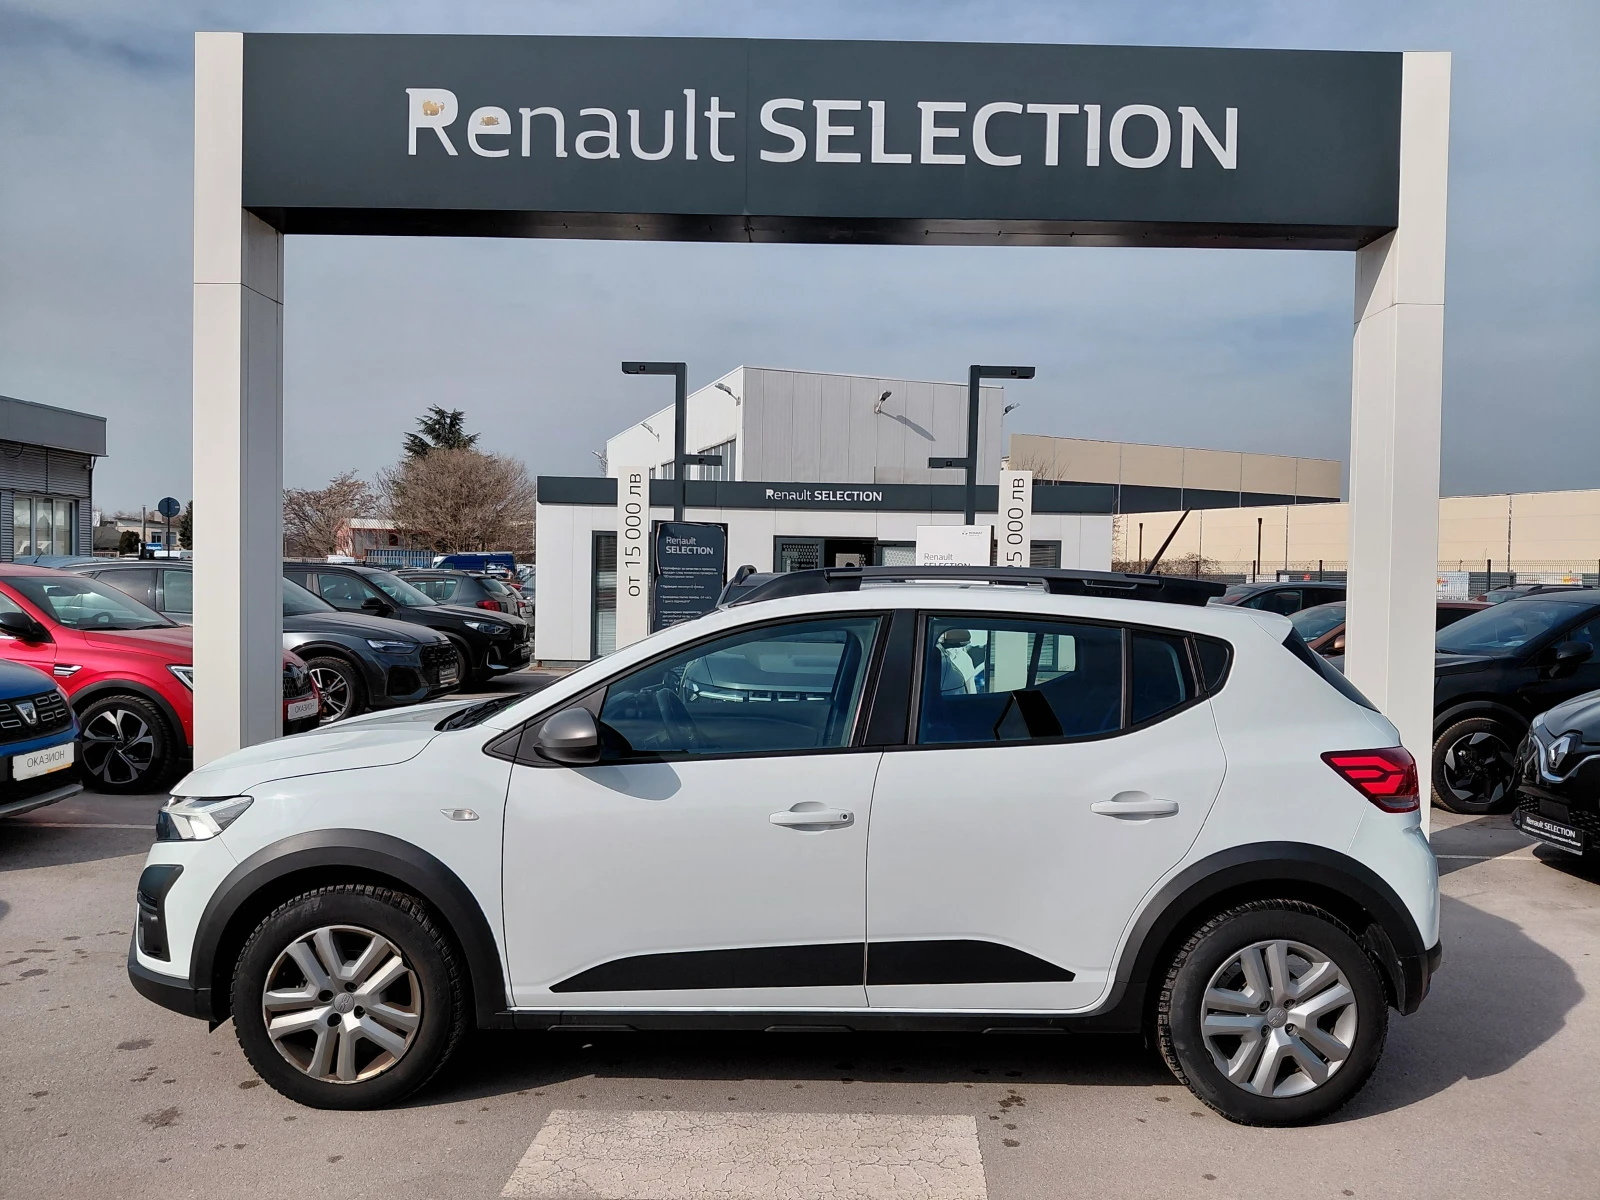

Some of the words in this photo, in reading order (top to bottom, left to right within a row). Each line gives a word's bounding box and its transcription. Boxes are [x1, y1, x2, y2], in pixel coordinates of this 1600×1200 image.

[406, 88, 735, 162] Renault
[760, 98, 1238, 170] SELECTION
[765, 489, 811, 500] Renault
[814, 490, 882, 501] SELECTION
[625, 503, 641, 540] 000
[1007, 508, 1023, 545] 000
[666, 536, 696, 545] Renault
[625, 547, 641, 568] 15
[666, 546, 713, 555] SELECTION
[924, 553, 953, 561] Renault
[629, 576, 641, 597] от
[27, 750, 65, 768] ОКАЗИОН
[1544, 822, 1576, 838] SELECTION
